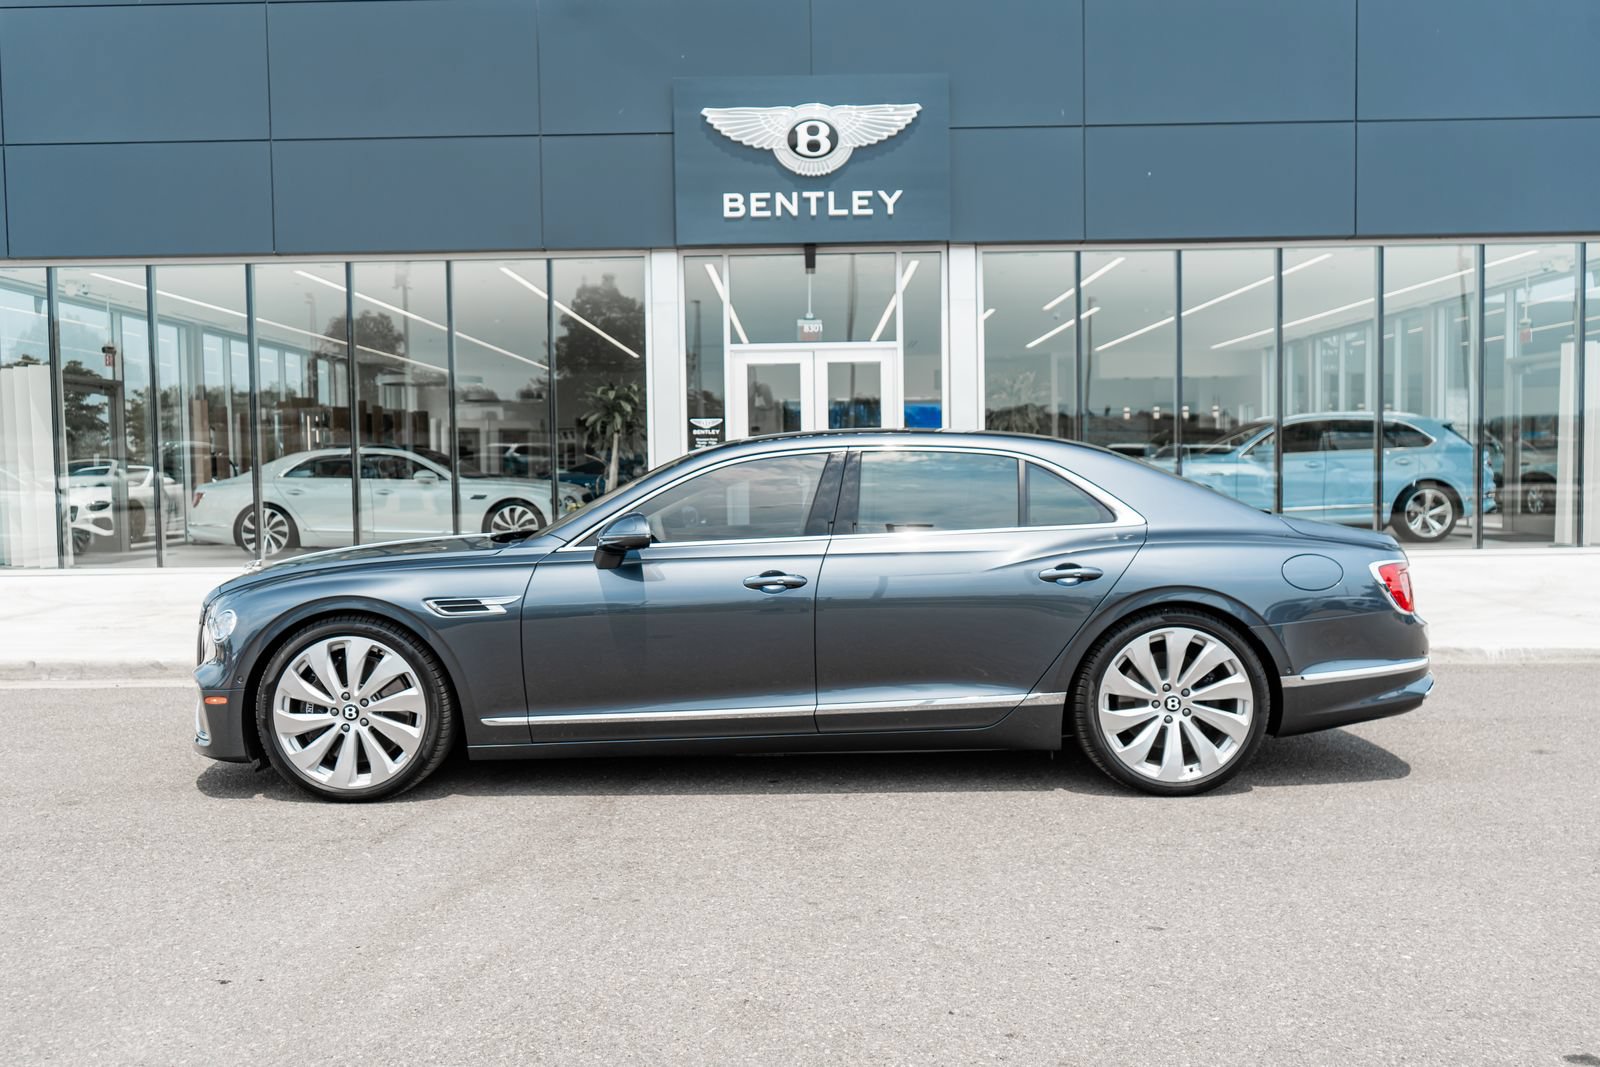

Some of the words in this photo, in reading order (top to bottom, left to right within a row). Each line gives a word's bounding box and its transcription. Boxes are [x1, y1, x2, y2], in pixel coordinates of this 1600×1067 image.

[795, 120, 832, 158] B
[722, 189, 904, 219] BENTLEY
[344, 706, 357, 719] B
[1167, 697, 1180, 710] B
